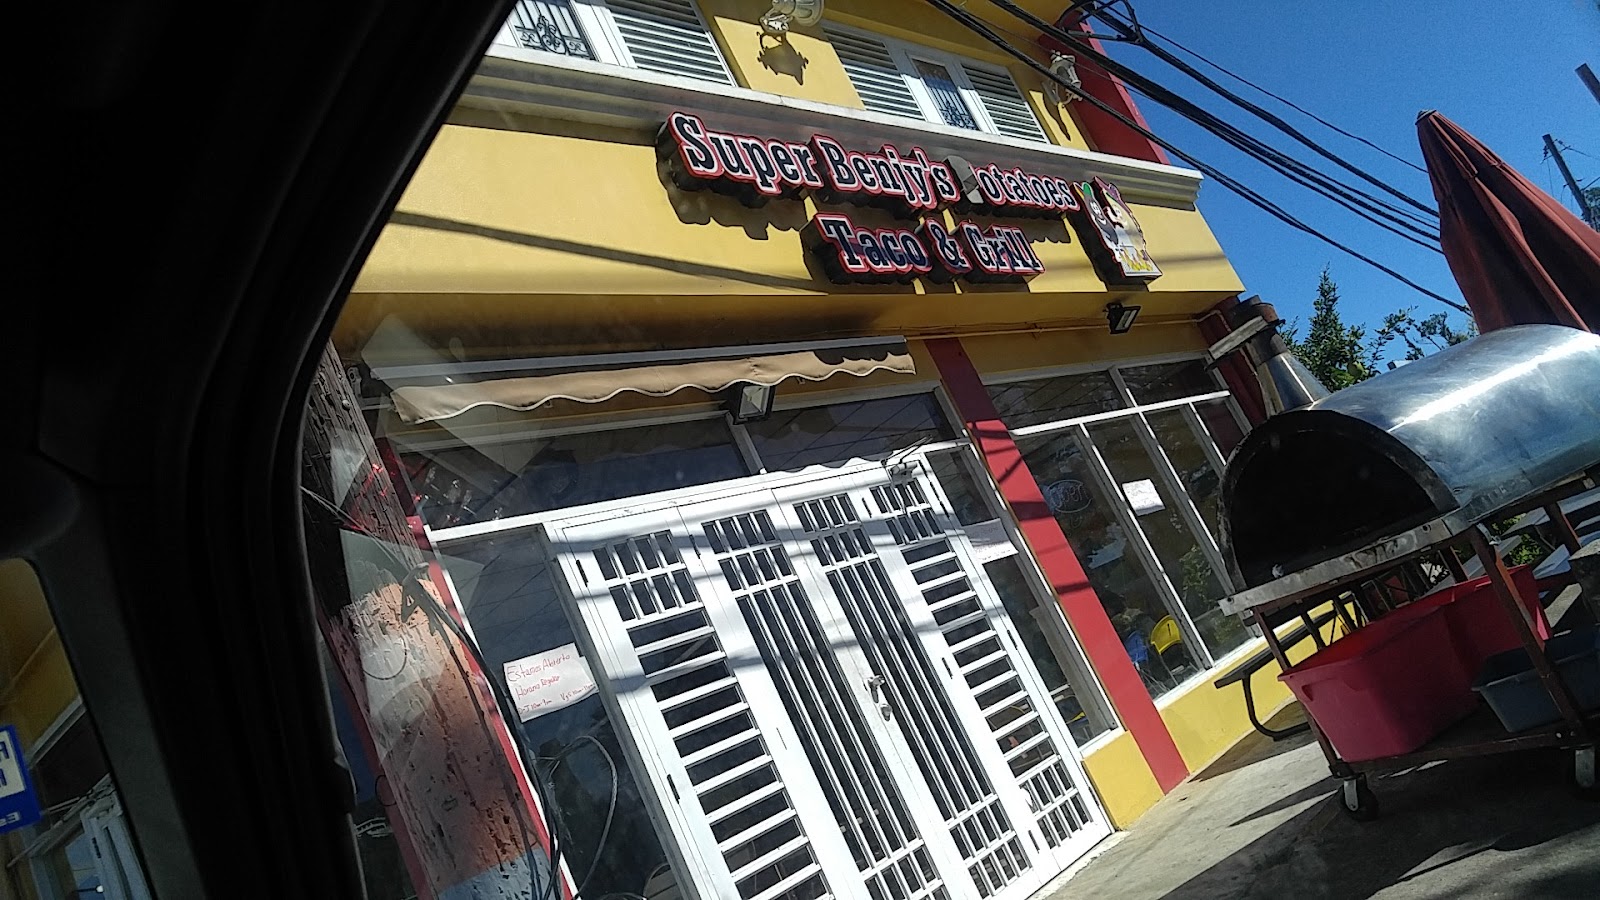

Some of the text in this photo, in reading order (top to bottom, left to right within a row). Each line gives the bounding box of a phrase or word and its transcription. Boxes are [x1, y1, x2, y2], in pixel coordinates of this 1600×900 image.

[673, 112, 1081, 210] Super Benjy's otatoes
[819, 216, 1042, 273] Taco & Grill
